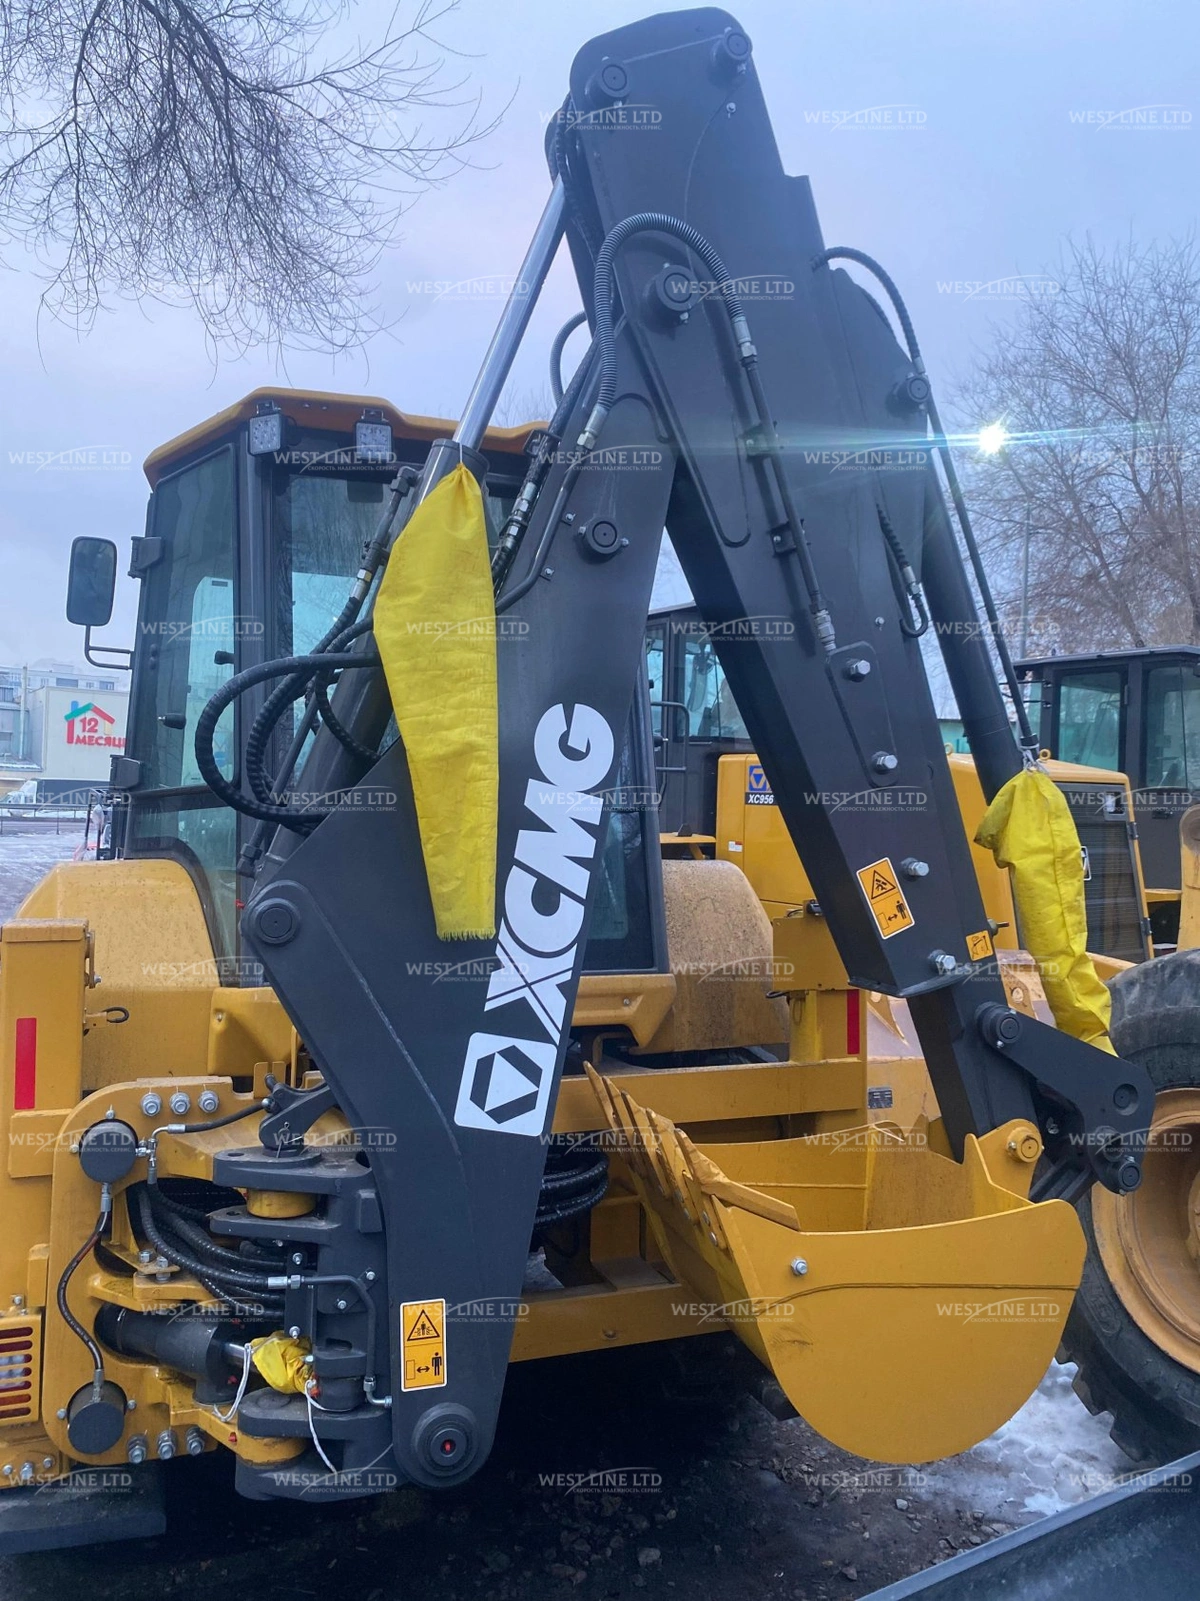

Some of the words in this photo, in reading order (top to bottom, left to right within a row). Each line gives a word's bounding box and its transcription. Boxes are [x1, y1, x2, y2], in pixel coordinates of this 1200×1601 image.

[79, 715, 98, 732] 12
[74, 733, 126, 747] МЕСЯЦ
[484, 703, 614, 1046] XCMG
